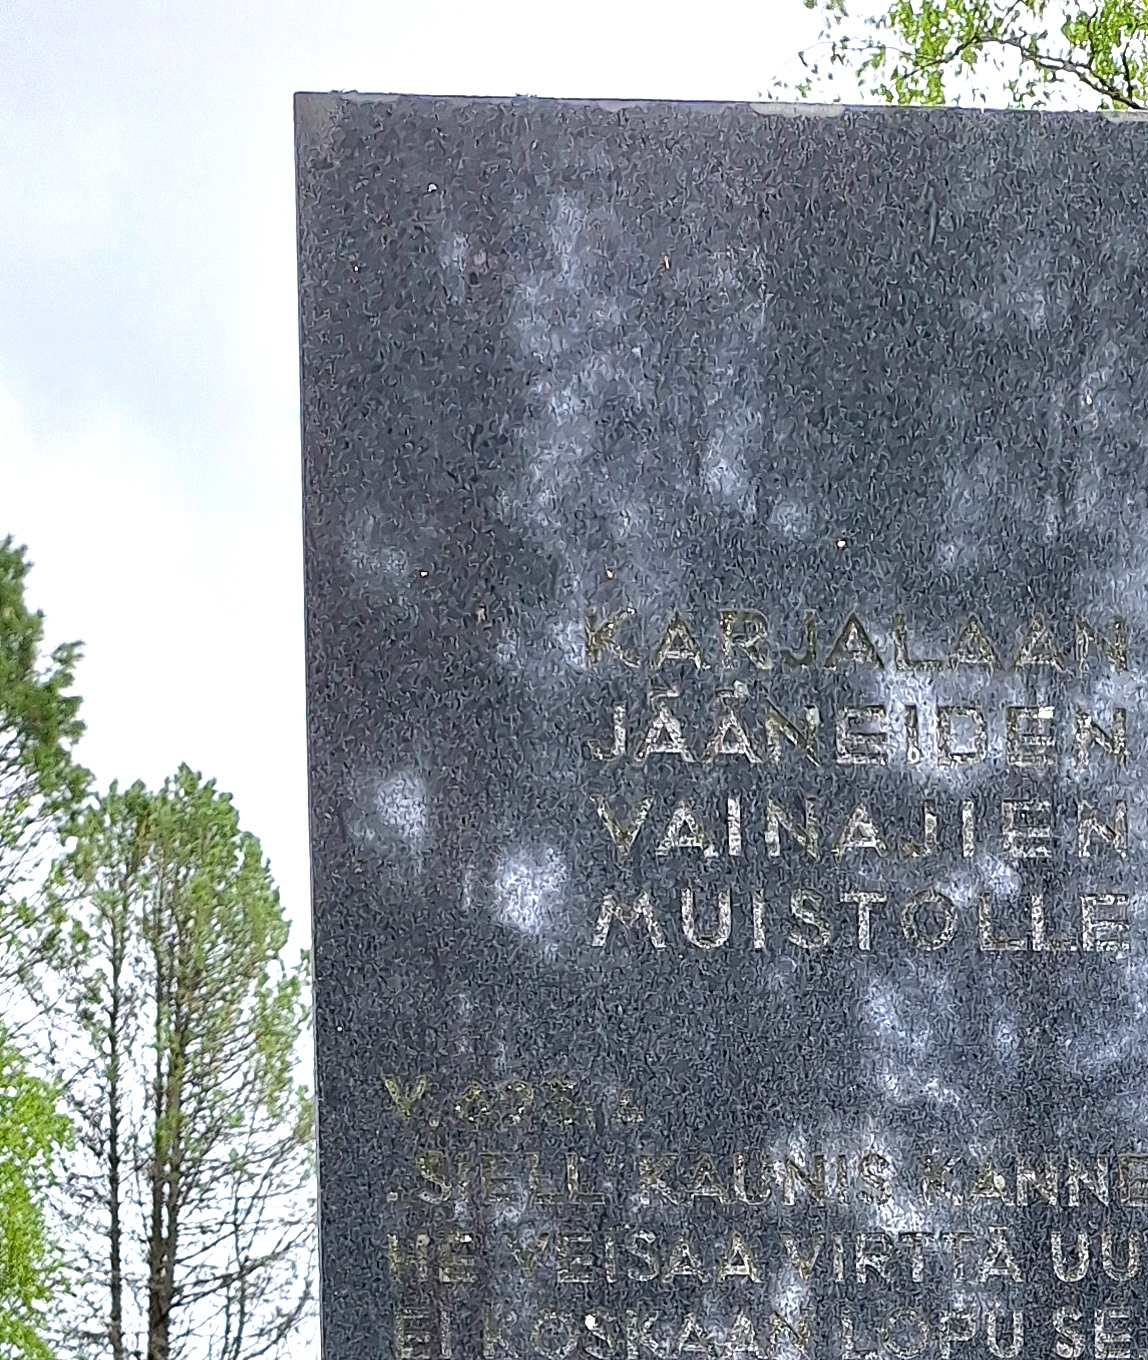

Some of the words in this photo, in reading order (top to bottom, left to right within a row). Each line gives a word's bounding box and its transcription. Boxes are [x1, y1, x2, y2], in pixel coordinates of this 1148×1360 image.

[583, 607, 1129, 671] KARJALAAN
[587, 681, 1129, 766] JÄÄNEIDEN
[590, 797, 1128, 858] VAINAJIEN
[592, 888, 1131, 951] MUISTOLLE
[636, 1152, 896, 1207] KAUNIS
[386, 1230, 480, 1284] HE
[503, 1230, 763, 1284] VEISAA
[780, 1224, 1023, 1285] VIRTTÄ
